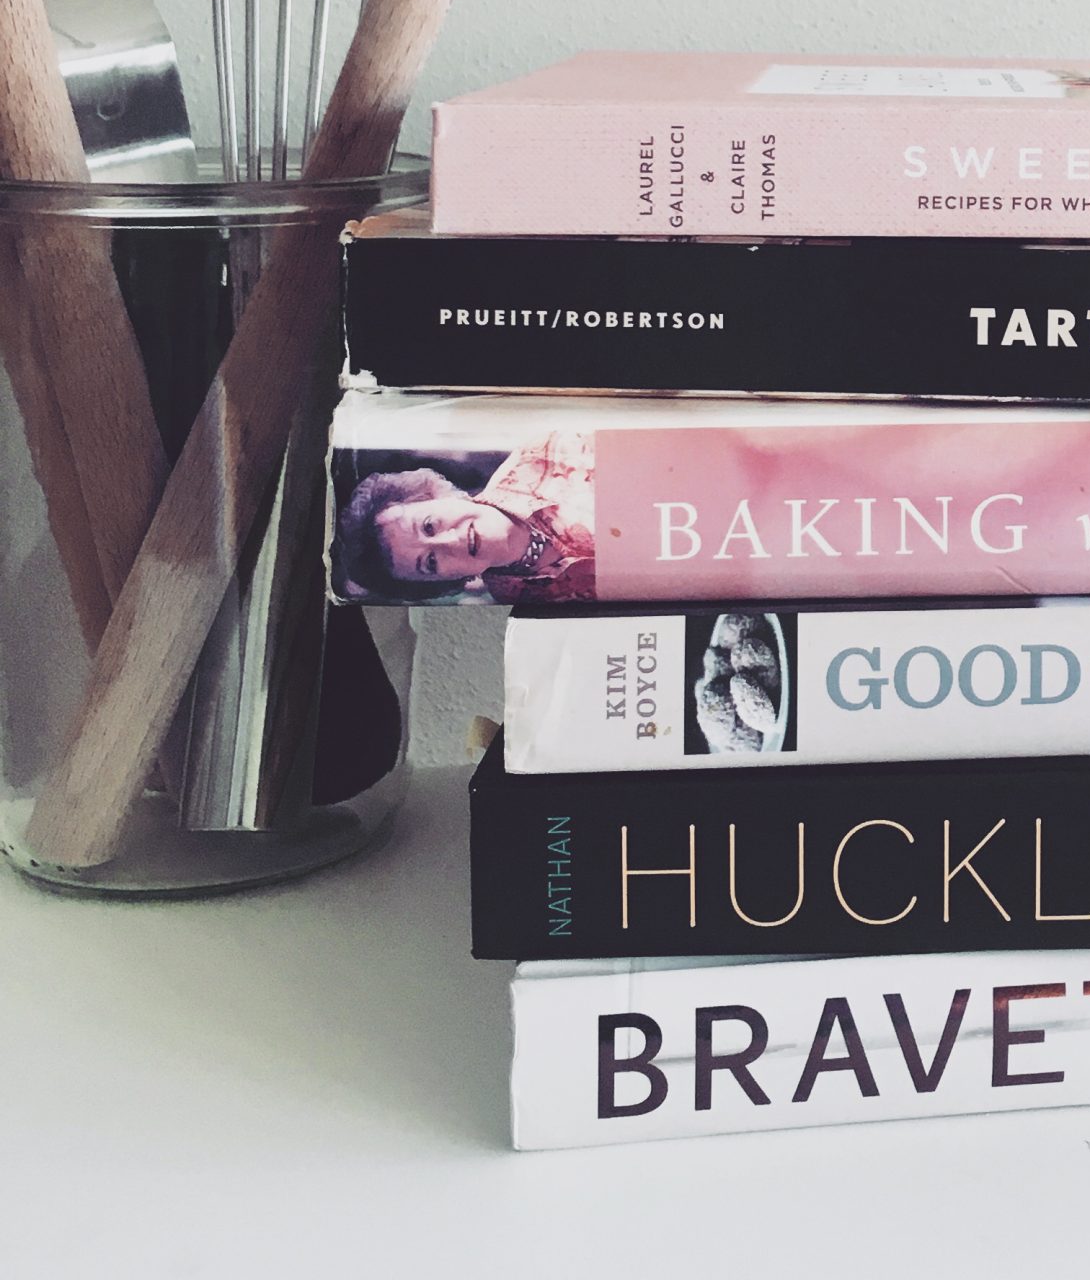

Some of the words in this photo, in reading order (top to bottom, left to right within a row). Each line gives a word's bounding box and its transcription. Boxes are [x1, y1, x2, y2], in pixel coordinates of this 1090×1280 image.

[639, 134, 655, 217] LAUREL
[669, 123, 686, 228] GALLUCCI
[730, 138, 747, 215] CLAIRE
[760, 133, 777, 221] THOMAS
[917, 195, 1004, 211] RECIPES
[1011, 197, 1054, 212] FOR
[439, 308, 726, 330] PRUEITT/ROBERTSON
[655, 494, 1028, 561] BAKING
[606, 653, 628, 720] KIM
[635, 630, 658, 741] BOYCE
[825, 643, 1083, 712] GOOD
[547, 816, 573, 938] NATHAN
